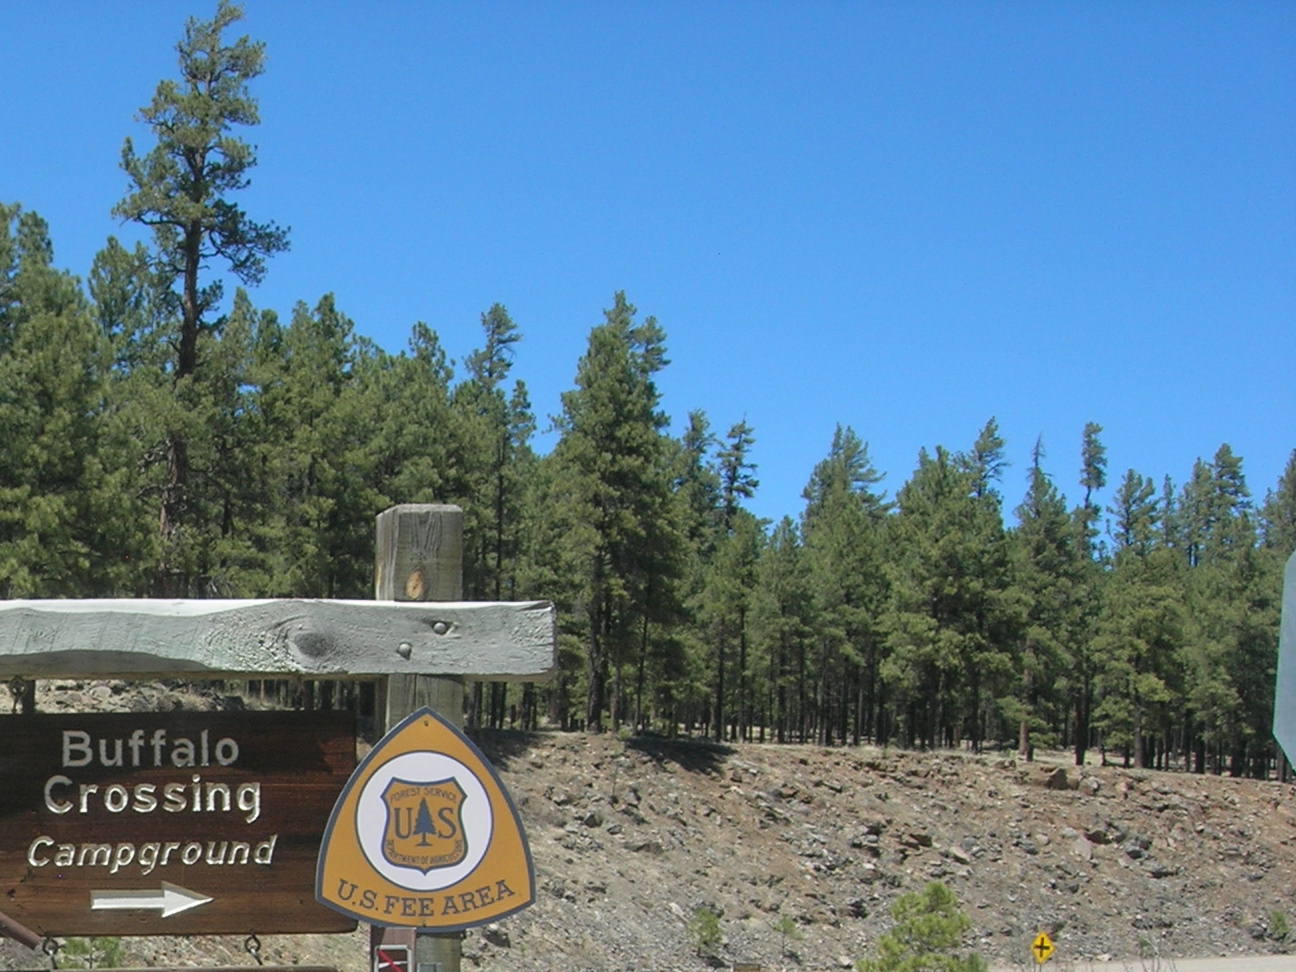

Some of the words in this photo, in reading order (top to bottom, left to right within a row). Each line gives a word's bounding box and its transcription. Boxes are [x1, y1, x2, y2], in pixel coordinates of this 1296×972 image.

[61, 729, 240, 768] Buffalo
[44, 773, 262, 823] Crossing
[27, 834, 278, 875] Campground
[337, 879, 380, 911] U.S.
[383, 895, 435, 917] FEE
[441, 879, 516, 916] AREA
